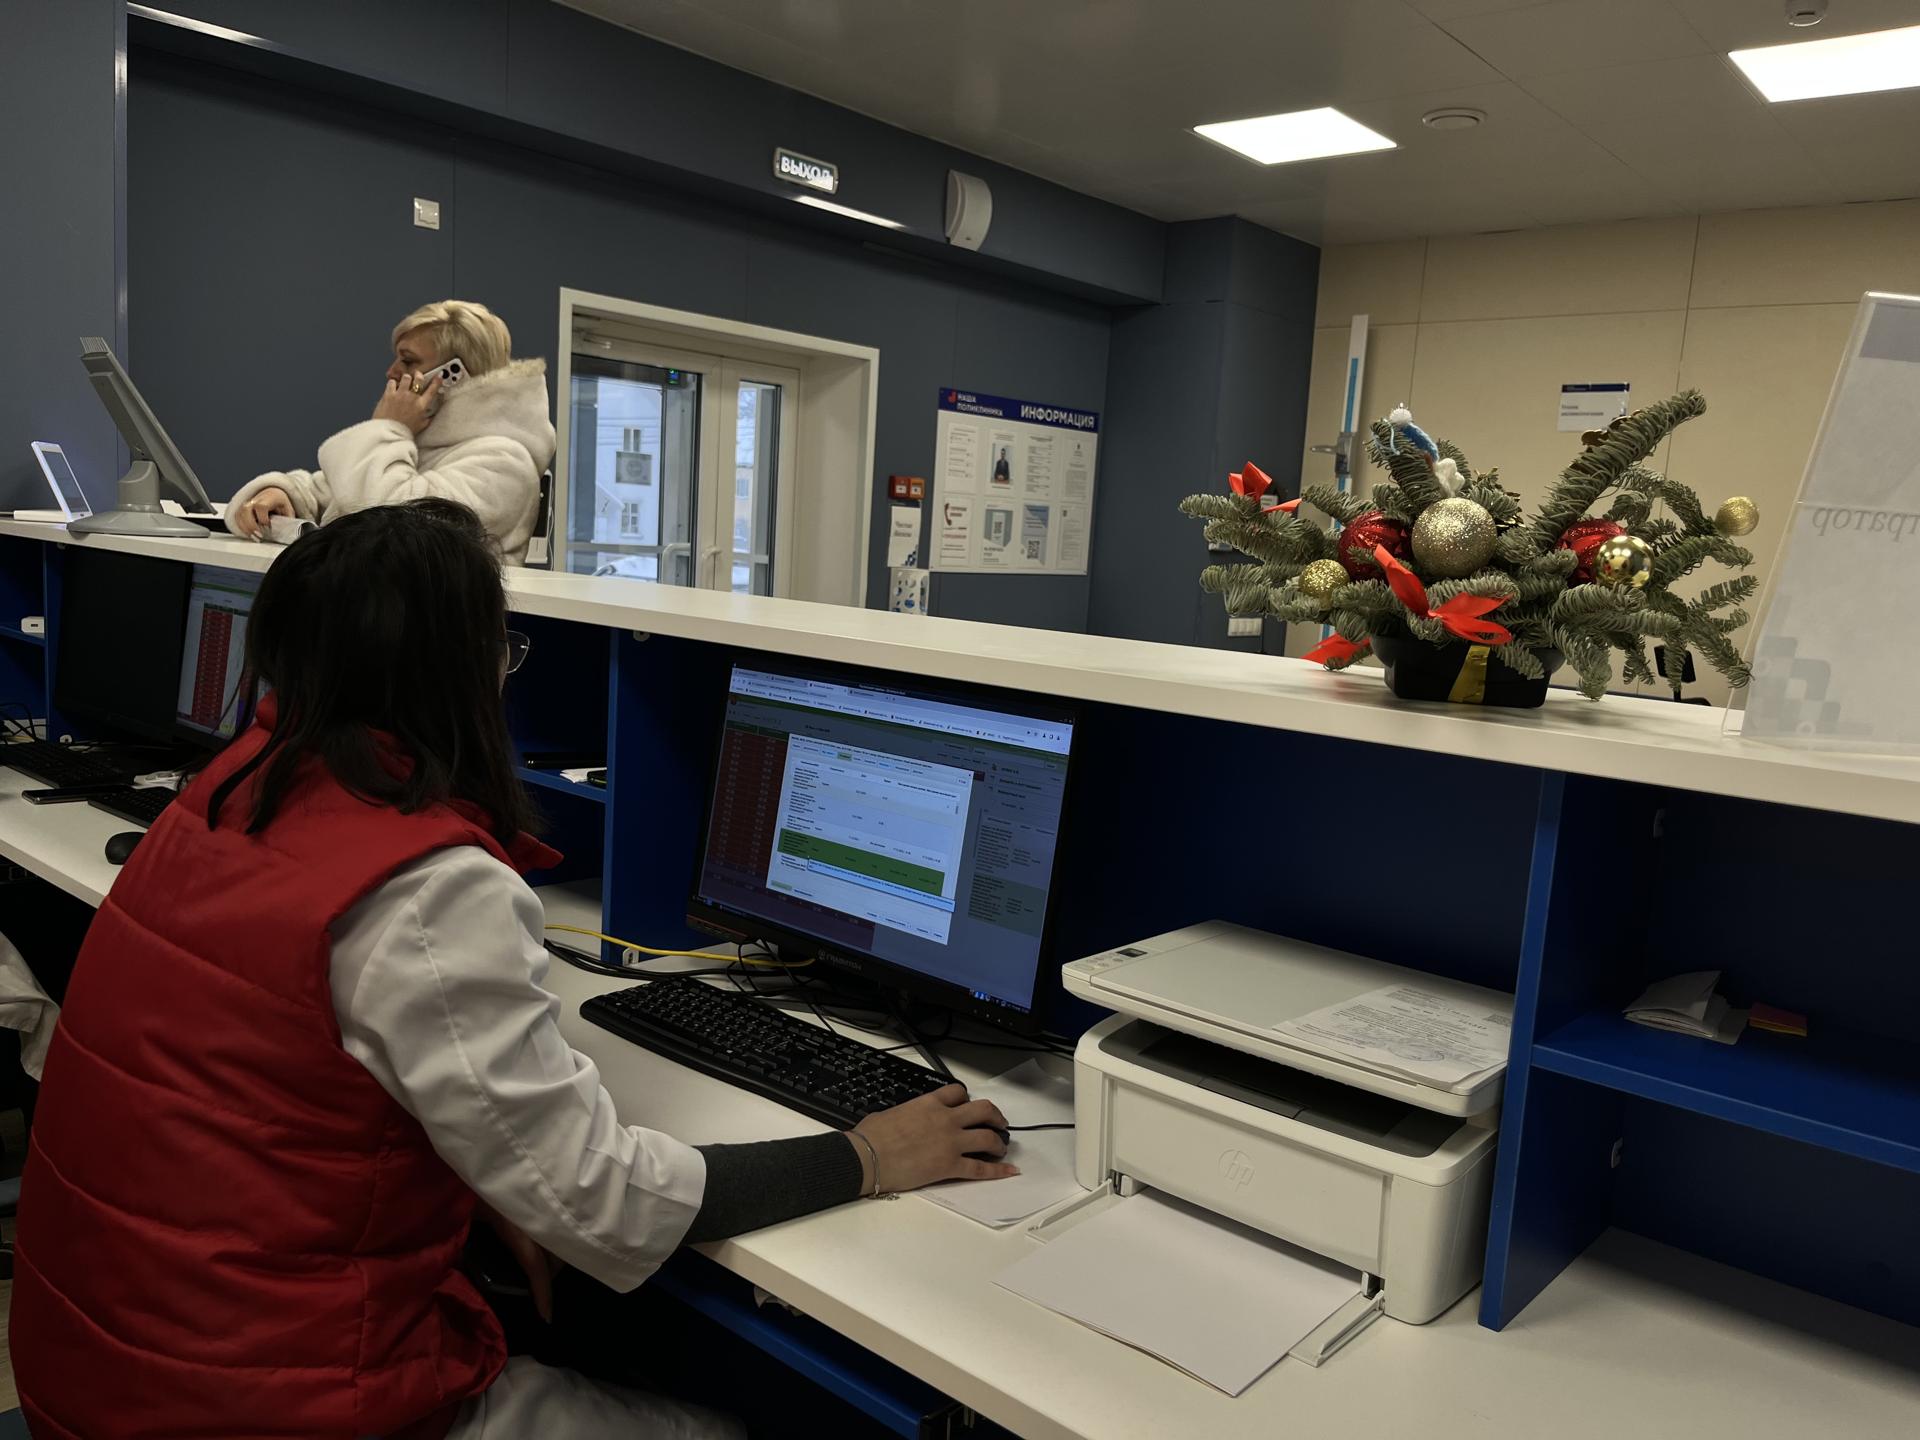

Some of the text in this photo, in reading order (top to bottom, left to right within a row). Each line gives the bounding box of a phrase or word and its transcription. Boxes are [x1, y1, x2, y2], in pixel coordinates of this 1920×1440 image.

[781, 156, 833, 189] ВЫХОД
[957, 402, 1003, 417] ПОЛИКЛИНИКА
[1020, 404, 1095, 429] ИНФОРМАЦИЯ
